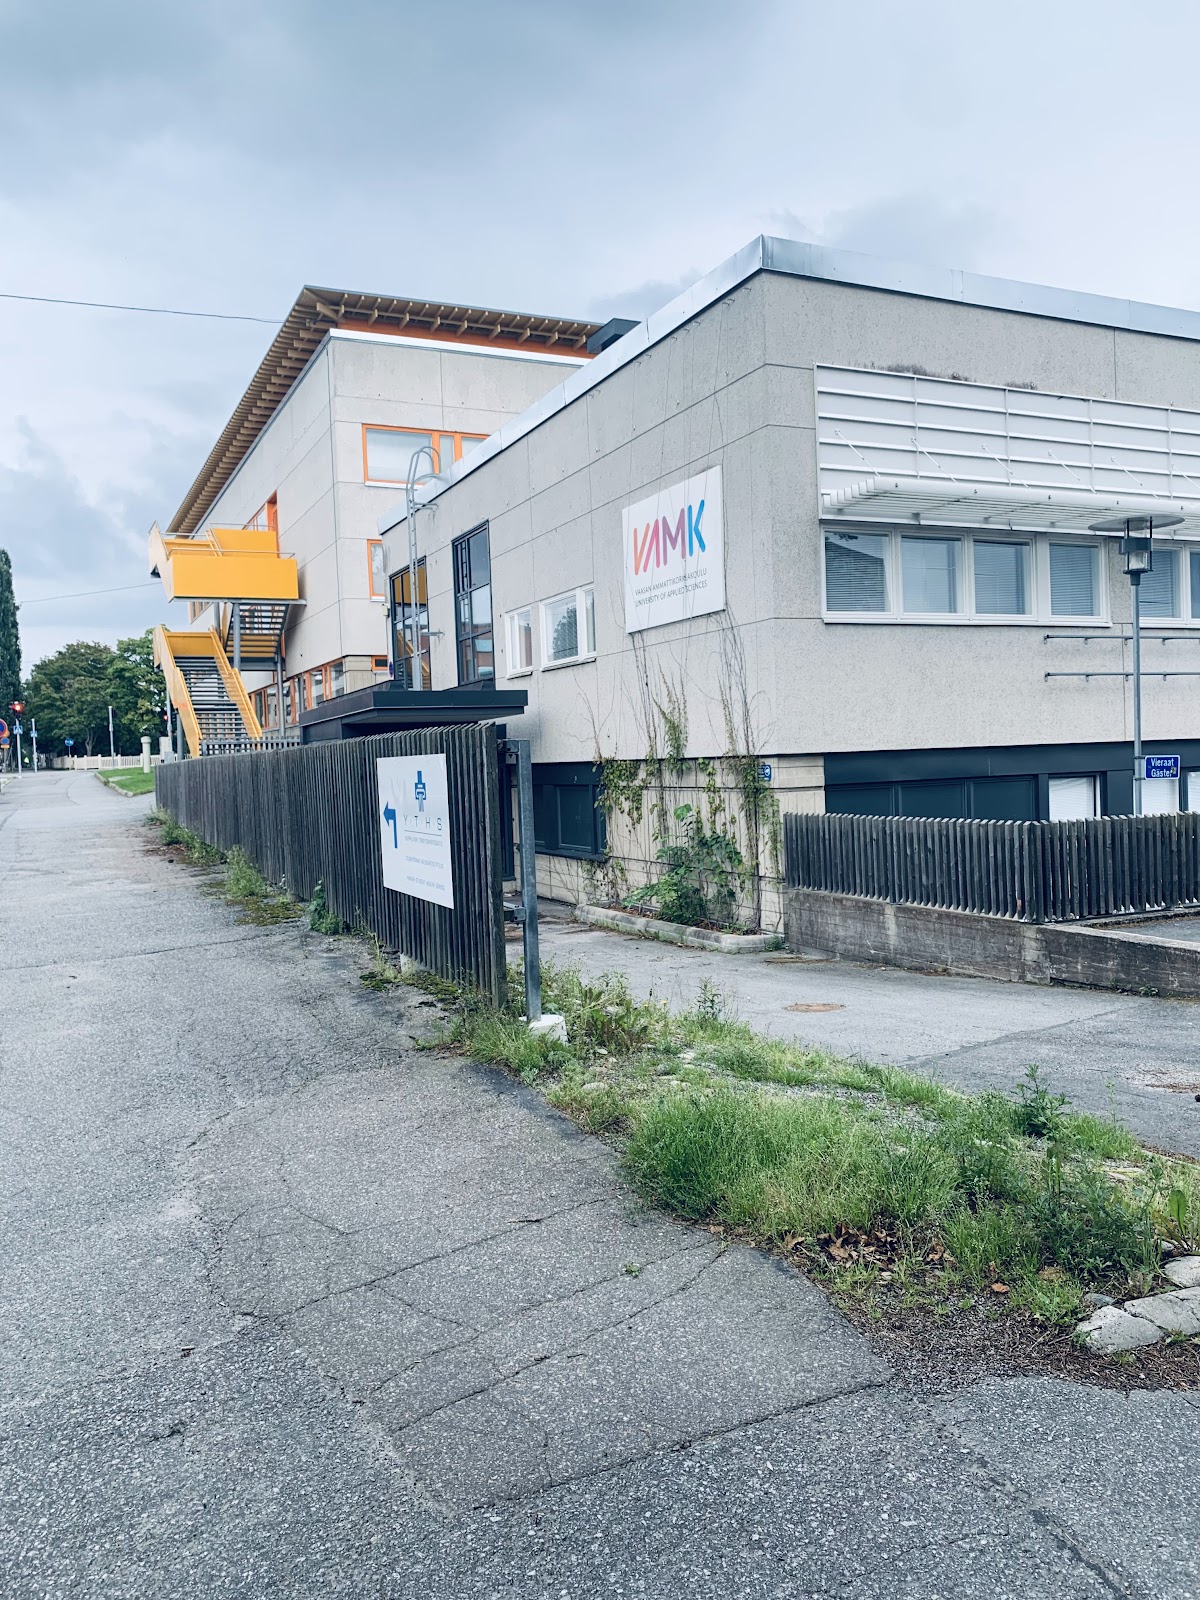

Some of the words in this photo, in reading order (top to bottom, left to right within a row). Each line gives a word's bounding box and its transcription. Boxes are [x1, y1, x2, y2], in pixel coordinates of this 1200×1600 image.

[634, 500, 706, 576] VAMK
[635, 586, 652, 596] VAASAN
[635, 594, 660, 607] UNIVERSITY
[667, 587, 684, 596] APPLIED
[685, 580, 707, 592] SCIENCES
[1150, 758, 1174, 766] Vieraat
